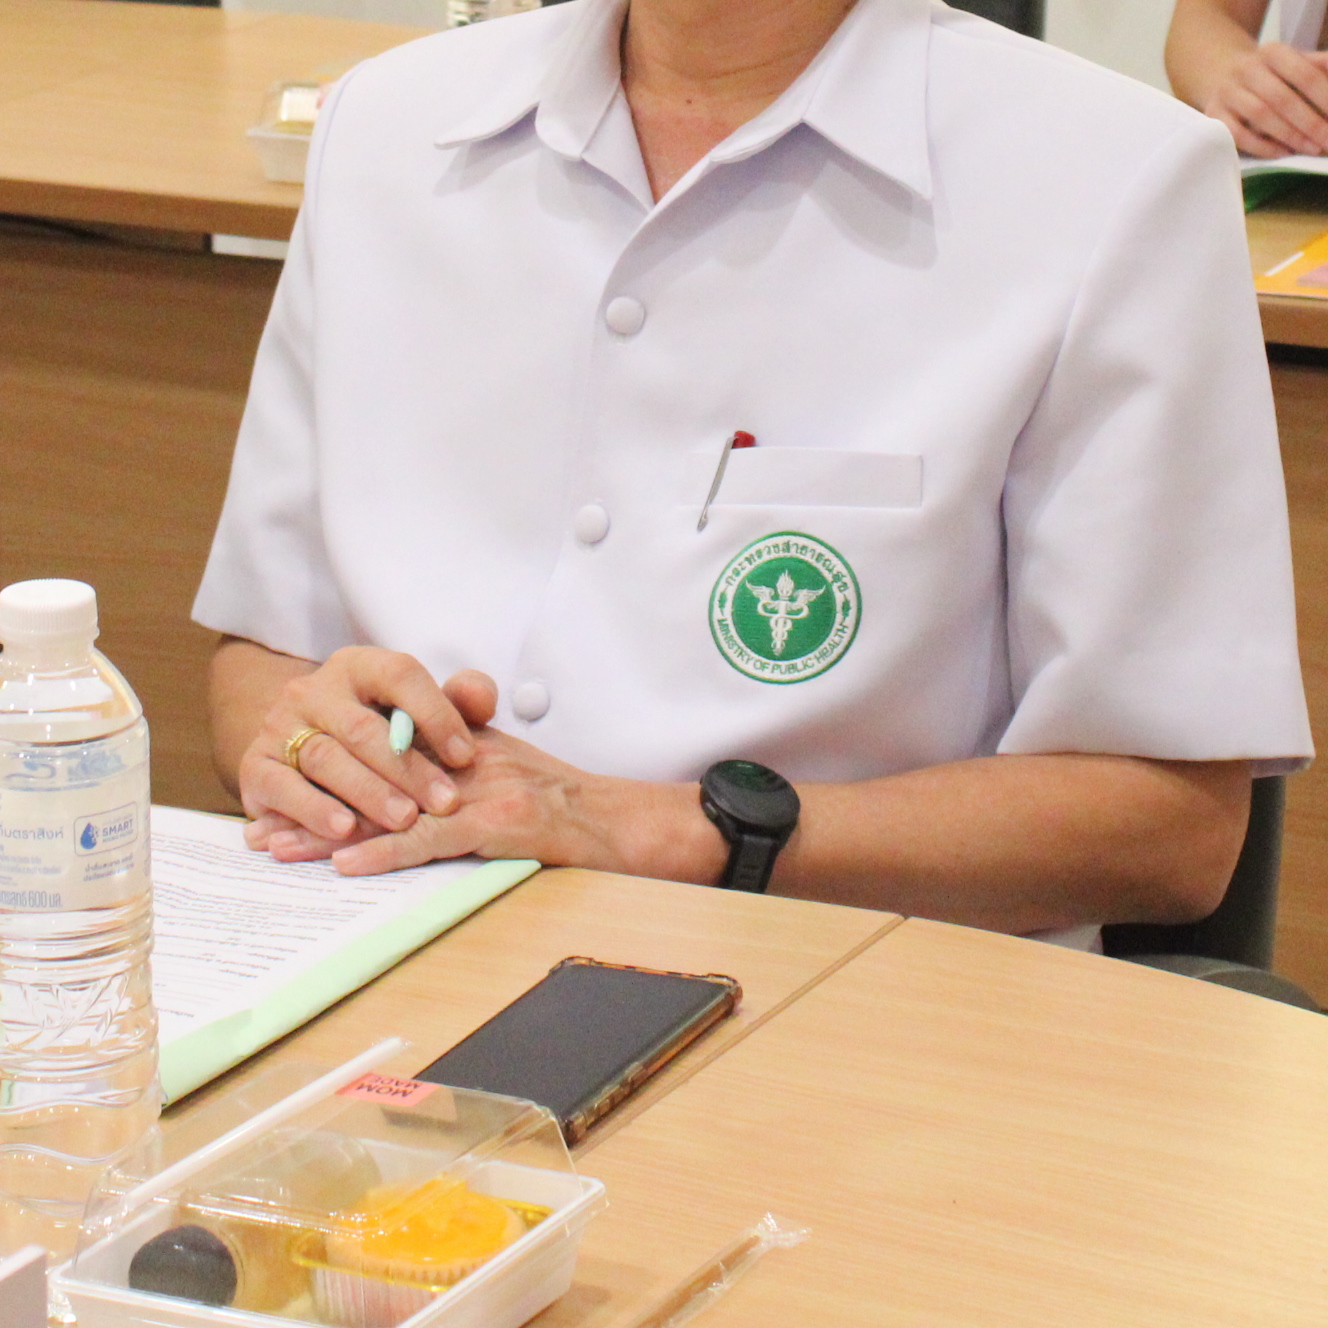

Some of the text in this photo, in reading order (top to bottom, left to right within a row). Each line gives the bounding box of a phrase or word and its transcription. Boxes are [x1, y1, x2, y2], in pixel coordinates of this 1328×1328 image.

[753, 657, 772, 672] OF
[772, 656, 815, 675] PUBLIC
[102, 818, 133, 837] SMART
[356, 1083, 414, 1098] MOM
